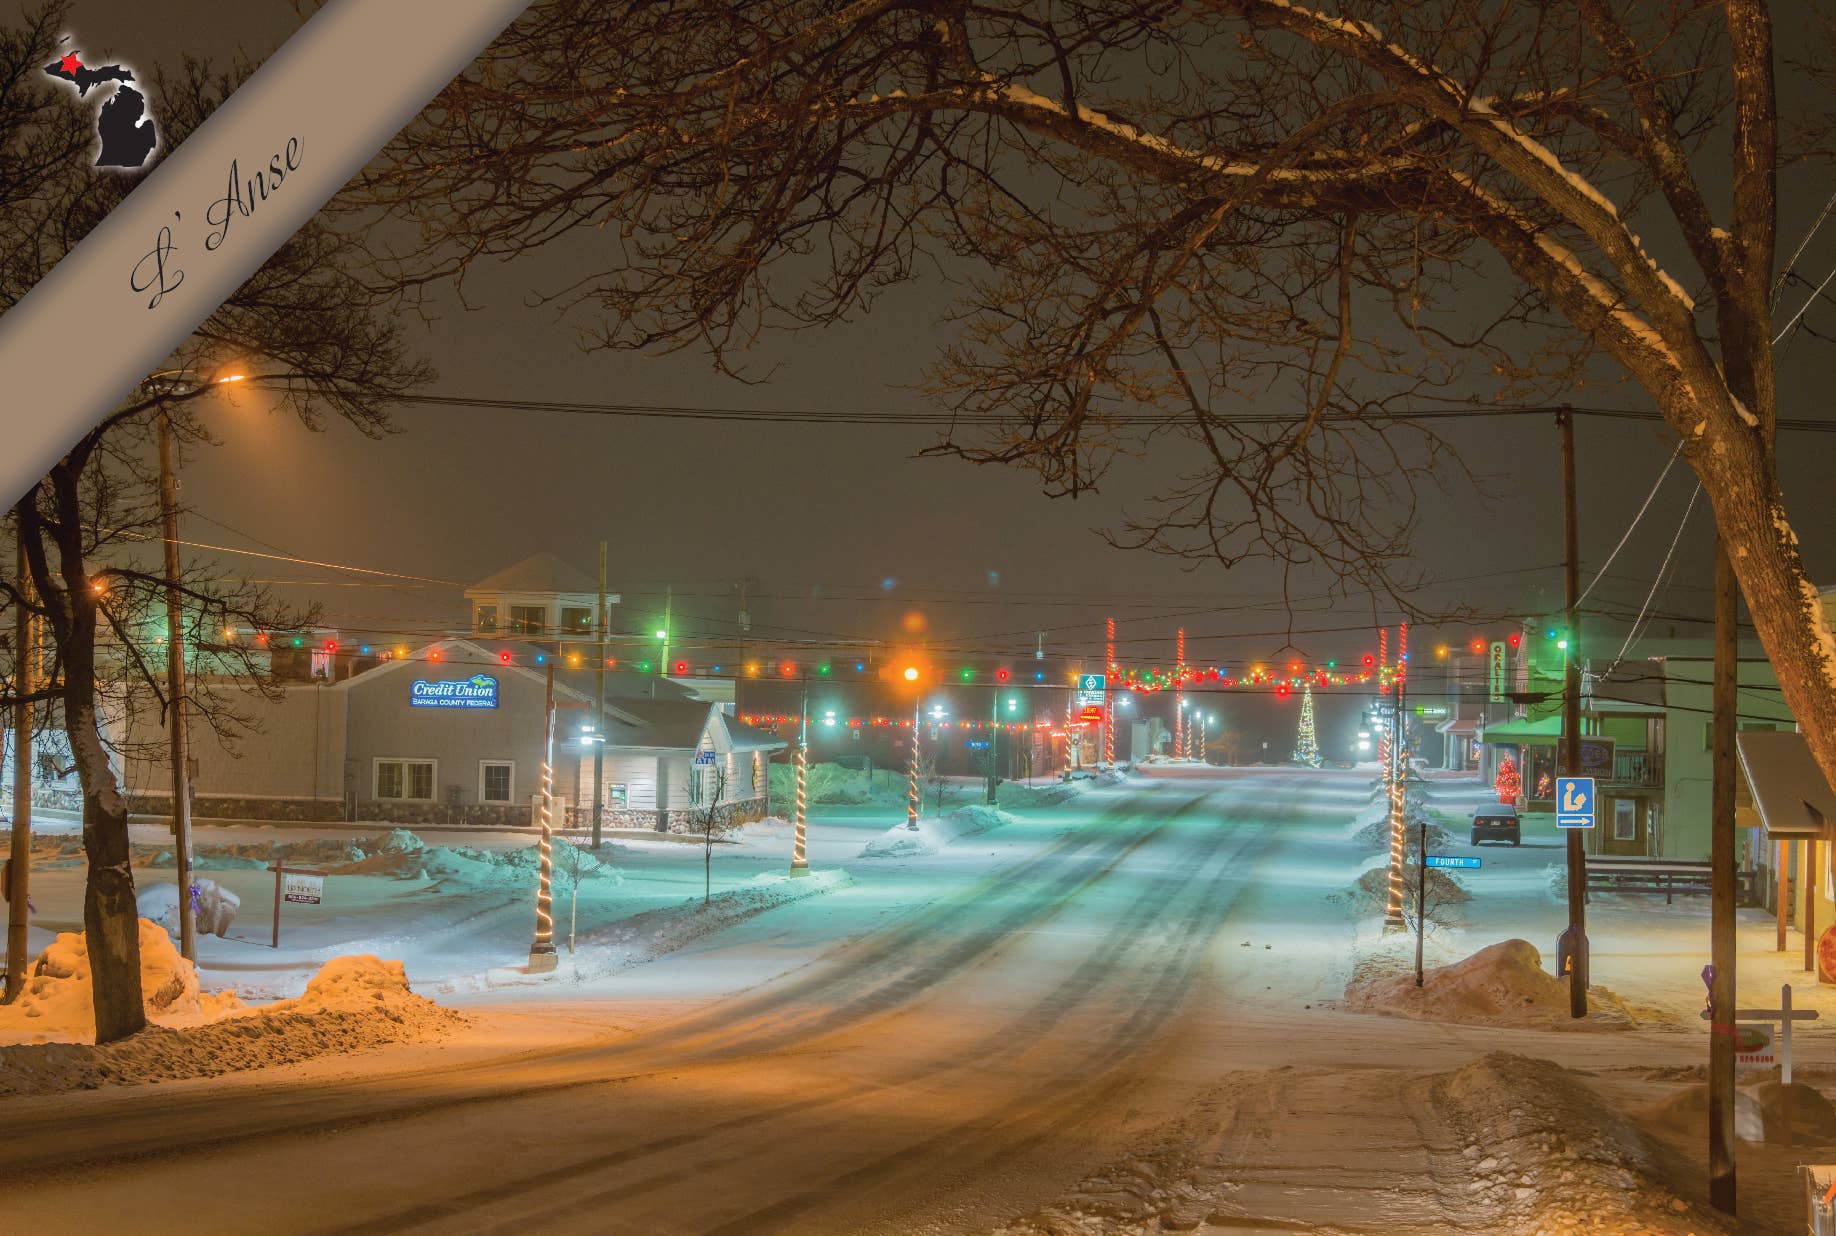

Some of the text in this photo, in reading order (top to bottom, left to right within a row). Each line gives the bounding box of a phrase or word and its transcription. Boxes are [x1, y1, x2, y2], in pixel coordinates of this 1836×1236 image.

[413, 683, 494, 697] Credit Union
[412, 698, 438, 706] BARAGA
[1435, 857, 1464, 867] FOURTH
